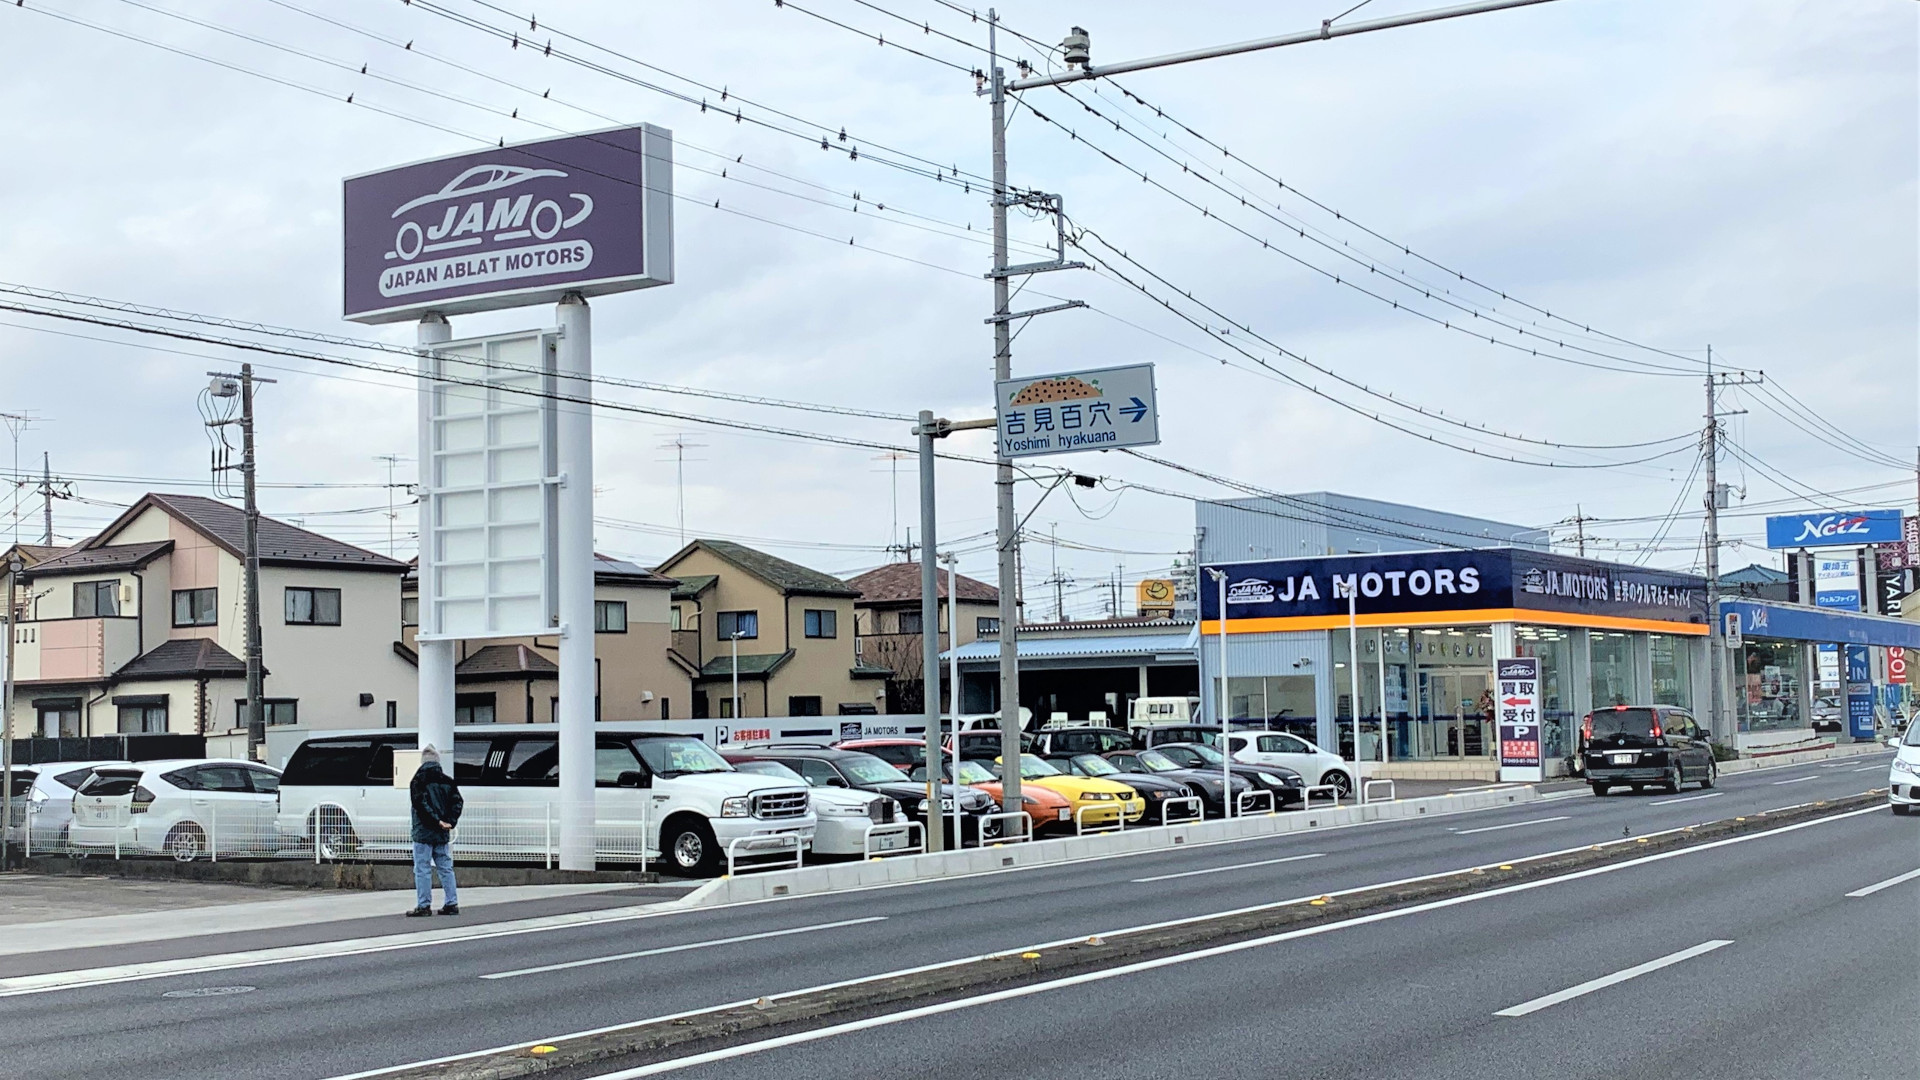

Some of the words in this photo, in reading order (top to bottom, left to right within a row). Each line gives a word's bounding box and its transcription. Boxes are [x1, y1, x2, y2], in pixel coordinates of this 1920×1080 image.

[427, 194, 533, 240] JAM
[385, 266, 438, 290] JAPAN
[443, 257, 500, 280] ABLAT
[506, 246, 585, 271] MOTORS
[1005, 401, 1112, 435] 吉見百穴
[1005, 434, 1050, 452] Yoshimi
[1058, 430, 1116, 449] hyakuana
[1794, 515, 1870, 542] Netz
[1278, 575, 1320, 602] JA
[1333, 566, 1480, 599] MOTORS
[1544, 569, 1560, 595] JA
[1562, 572, 1609, 601] MOTORS
[1613, 580, 1691, 609] 世界のクルマ&オートバイ
[1852, 667, 1867, 680] IN
[1501, 682, 1535, 696] 買取
[1503, 708, 1536, 723] 受付
[717, 726, 728, 745] P
[733, 729, 771, 741] お客様駐車場
[873, 727, 898, 735] MOTORS
[1514, 726, 1530, 739] P
